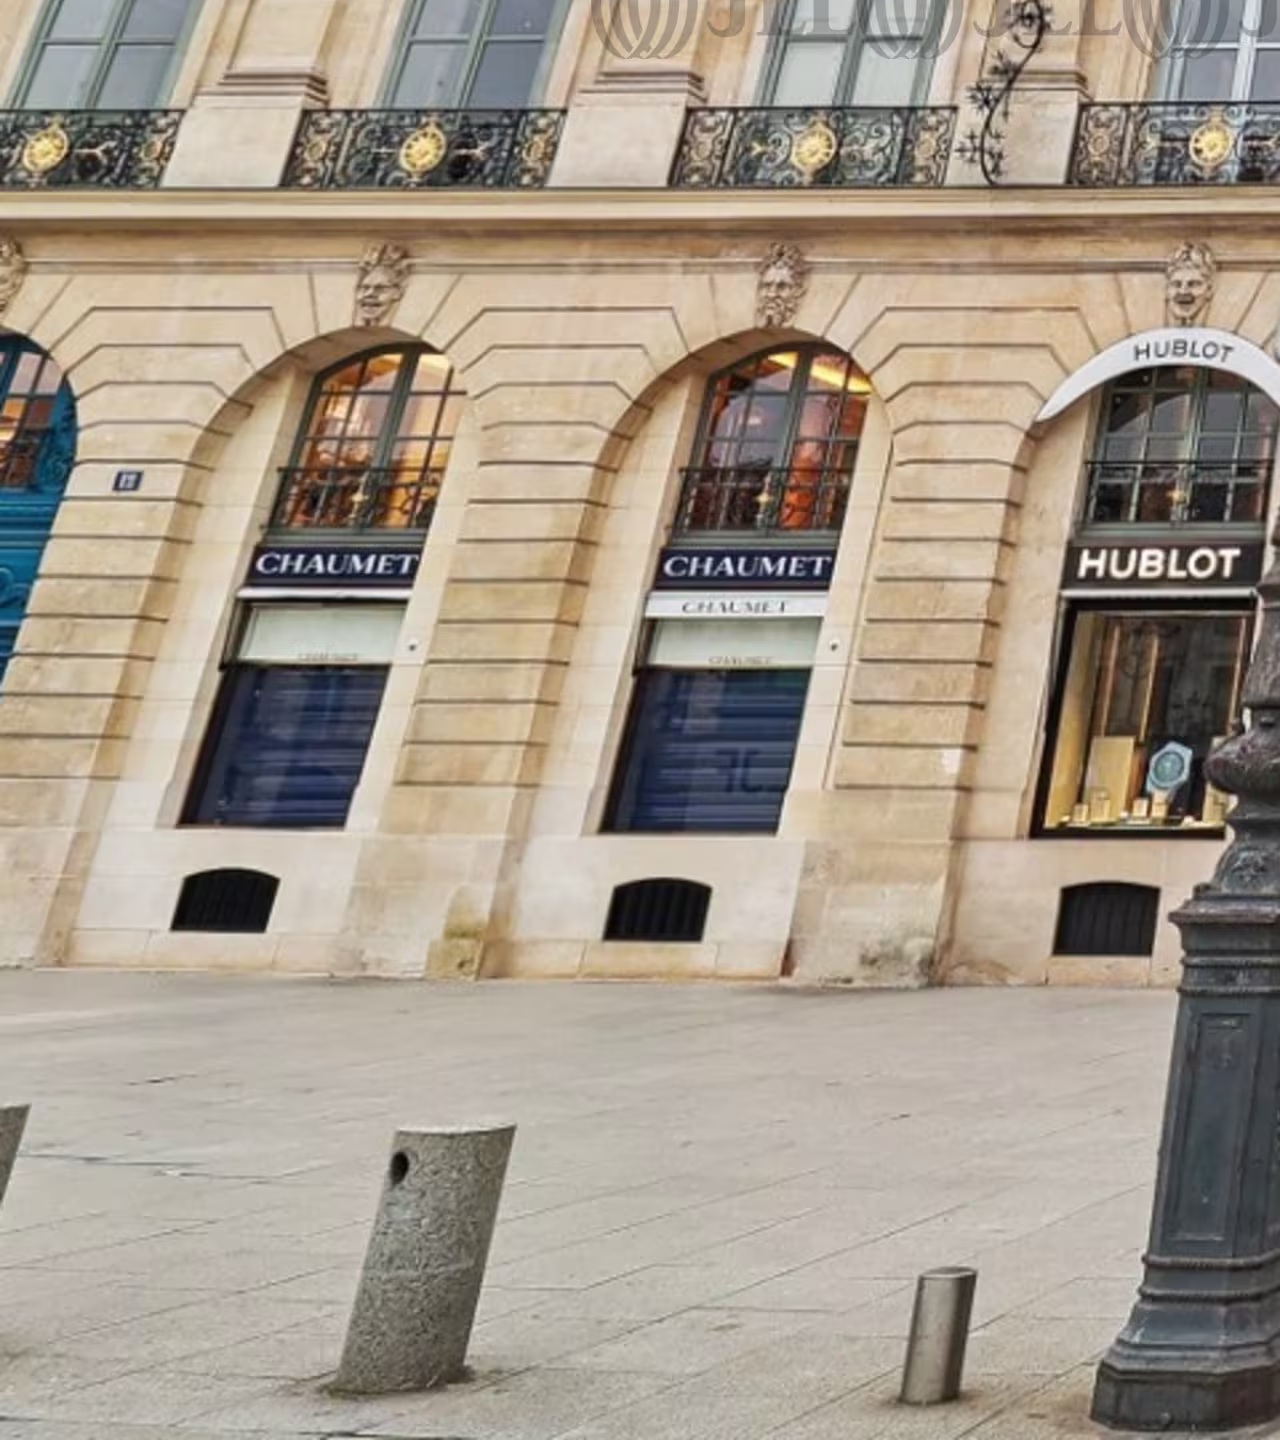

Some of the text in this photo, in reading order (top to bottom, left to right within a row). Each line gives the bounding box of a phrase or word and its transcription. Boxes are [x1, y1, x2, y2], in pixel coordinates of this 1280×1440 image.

[1134, 338, 1235, 362] HUBLOT
[255, 552, 420, 575] CHAUMET
[663, 555, 833, 577] CHAUMET
[1077, 548, 1241, 579] HUBLOT
[682, 600, 787, 614] CHAUMET
